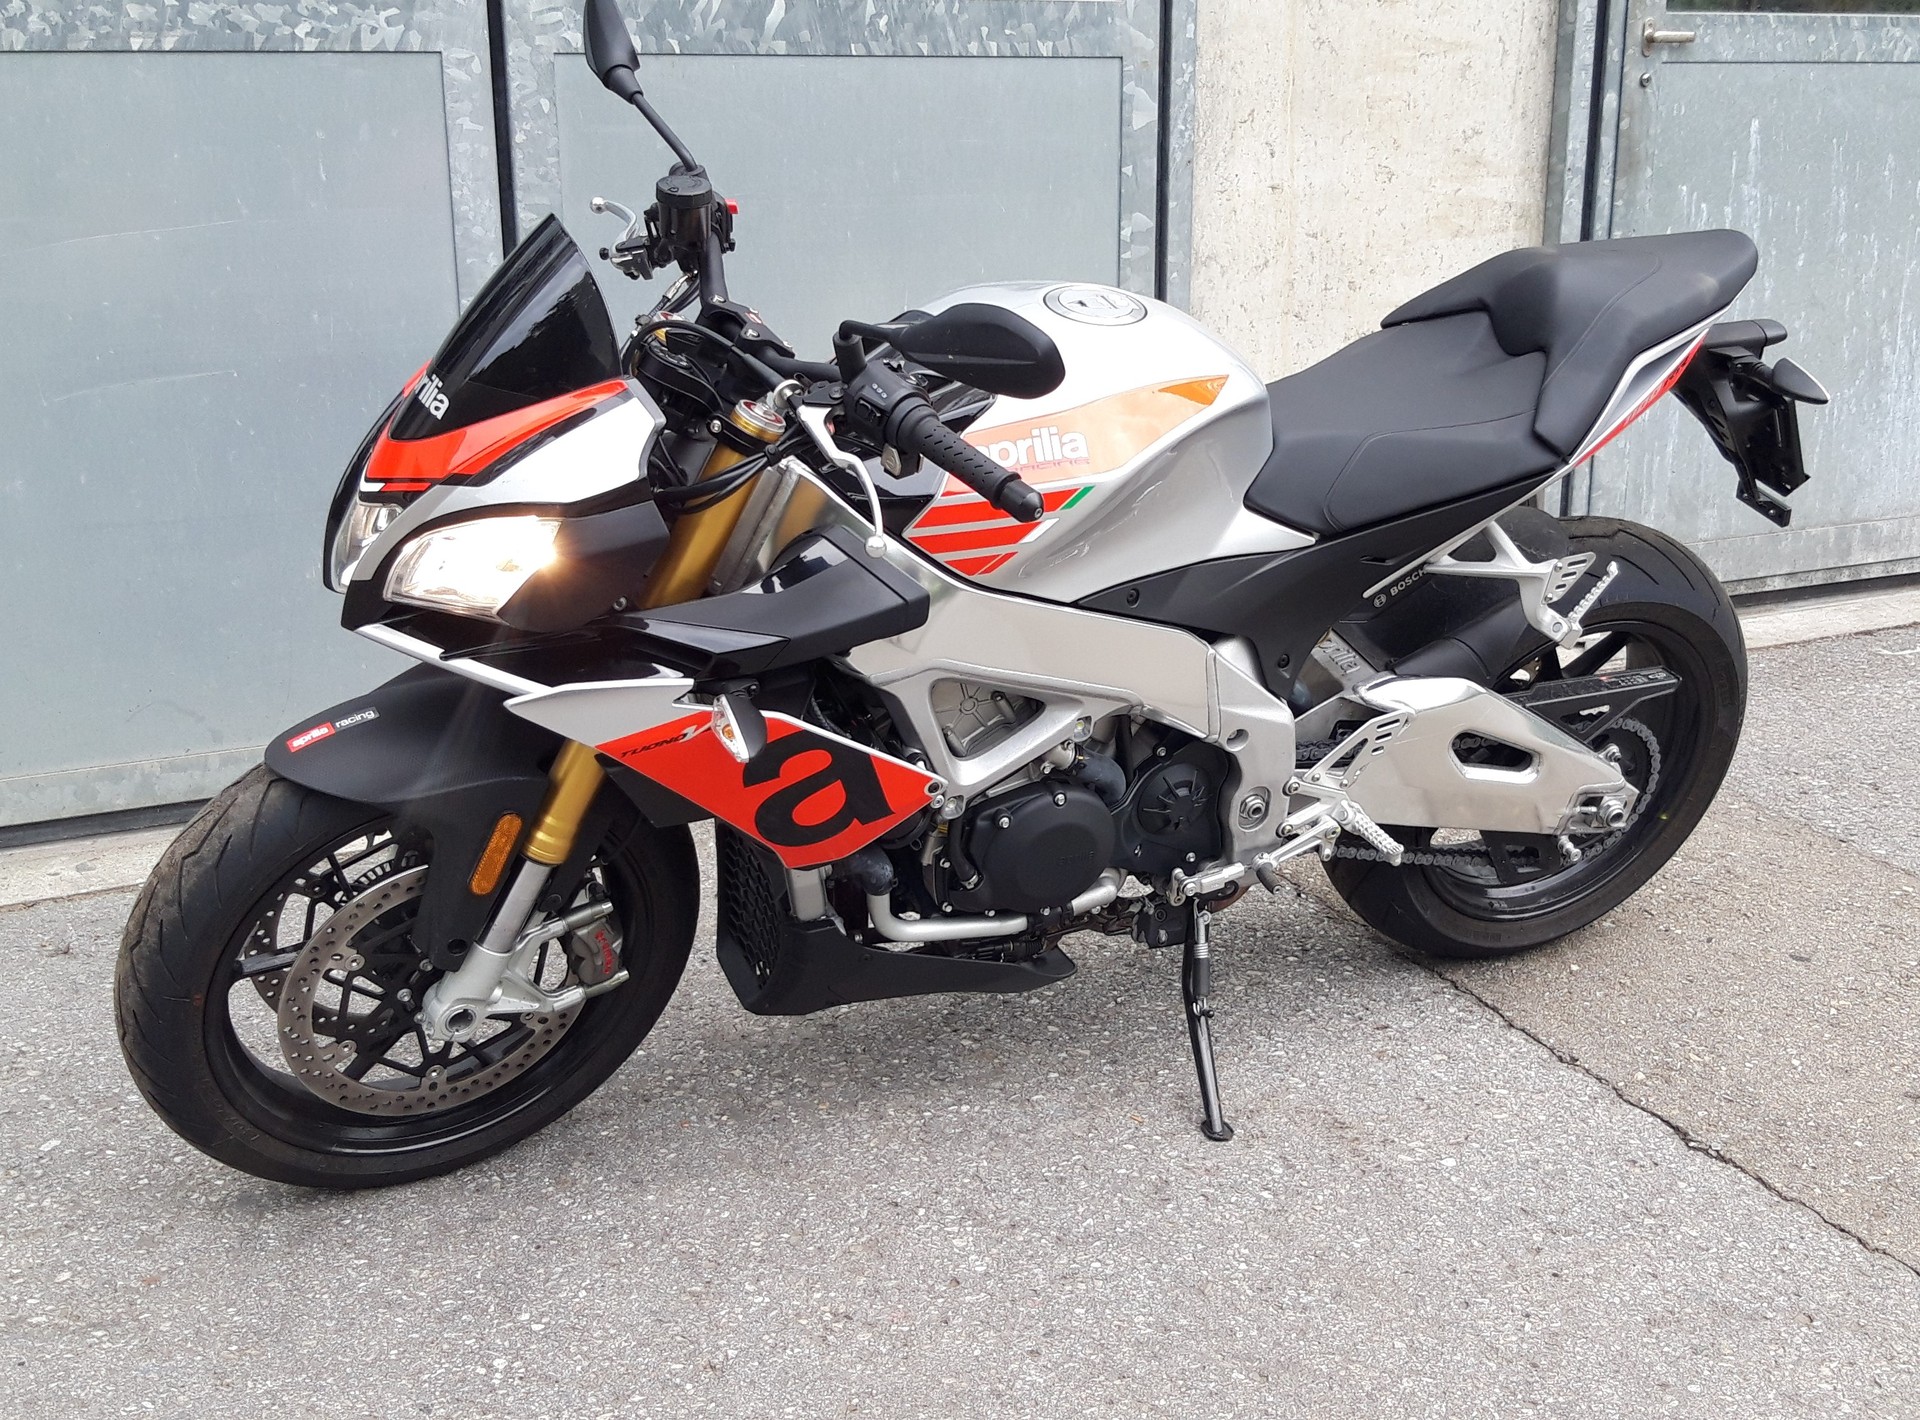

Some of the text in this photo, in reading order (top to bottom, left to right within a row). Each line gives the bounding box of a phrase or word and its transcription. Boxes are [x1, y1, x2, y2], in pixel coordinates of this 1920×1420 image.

[414, 373, 450, 420] rilia
[975, 426, 1090, 468] prilia
[292, 710, 375, 748] aprilia racing
[620, 732, 689, 758] TUONO
[743, 729, 896, 847] a
